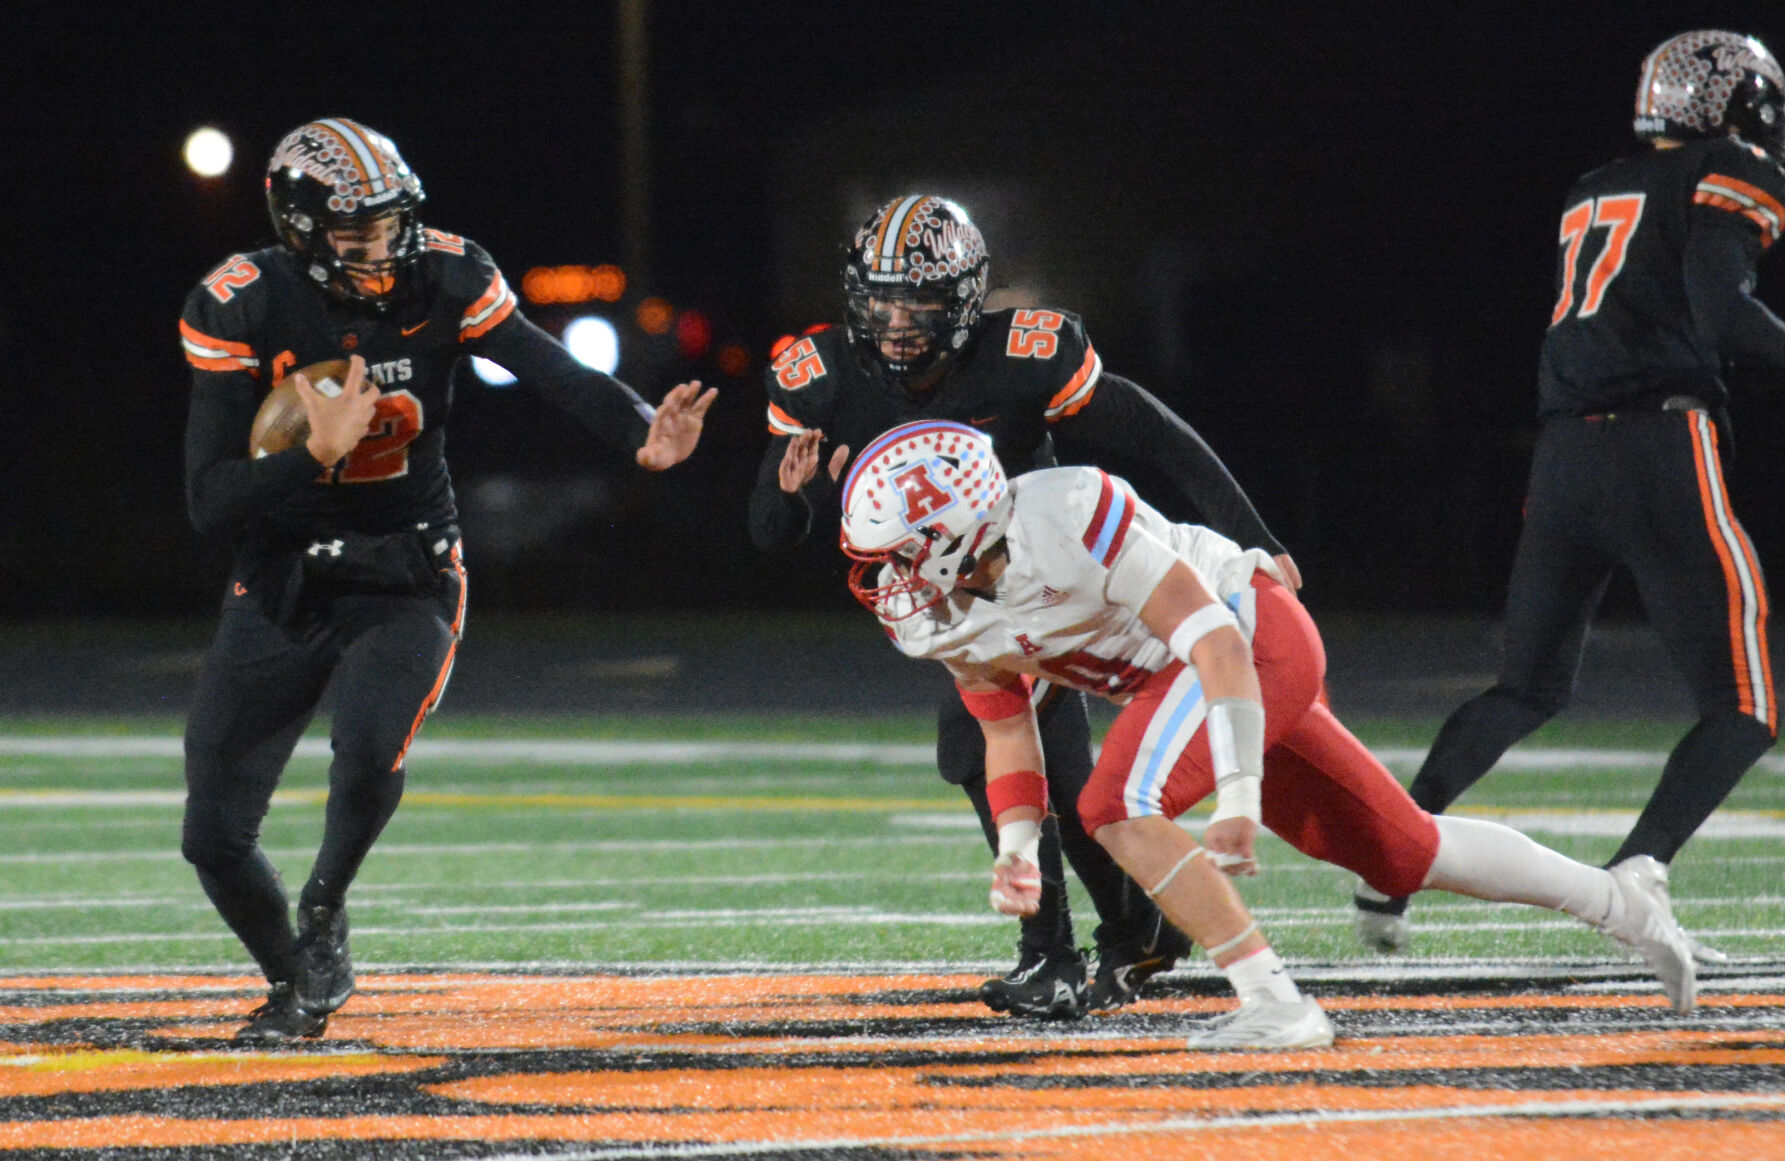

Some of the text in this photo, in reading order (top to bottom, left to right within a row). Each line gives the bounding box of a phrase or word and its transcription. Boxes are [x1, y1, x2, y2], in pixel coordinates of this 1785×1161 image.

[202, 253, 262, 304] 12
[1551, 192, 1646, 326] 77
[1006, 308, 1065, 360] 55
[362, 357, 413, 386] ATS
[770, 336, 828, 392] 55
[897, 462, 955, 527] A
[1014, 632, 1044, 657] A
